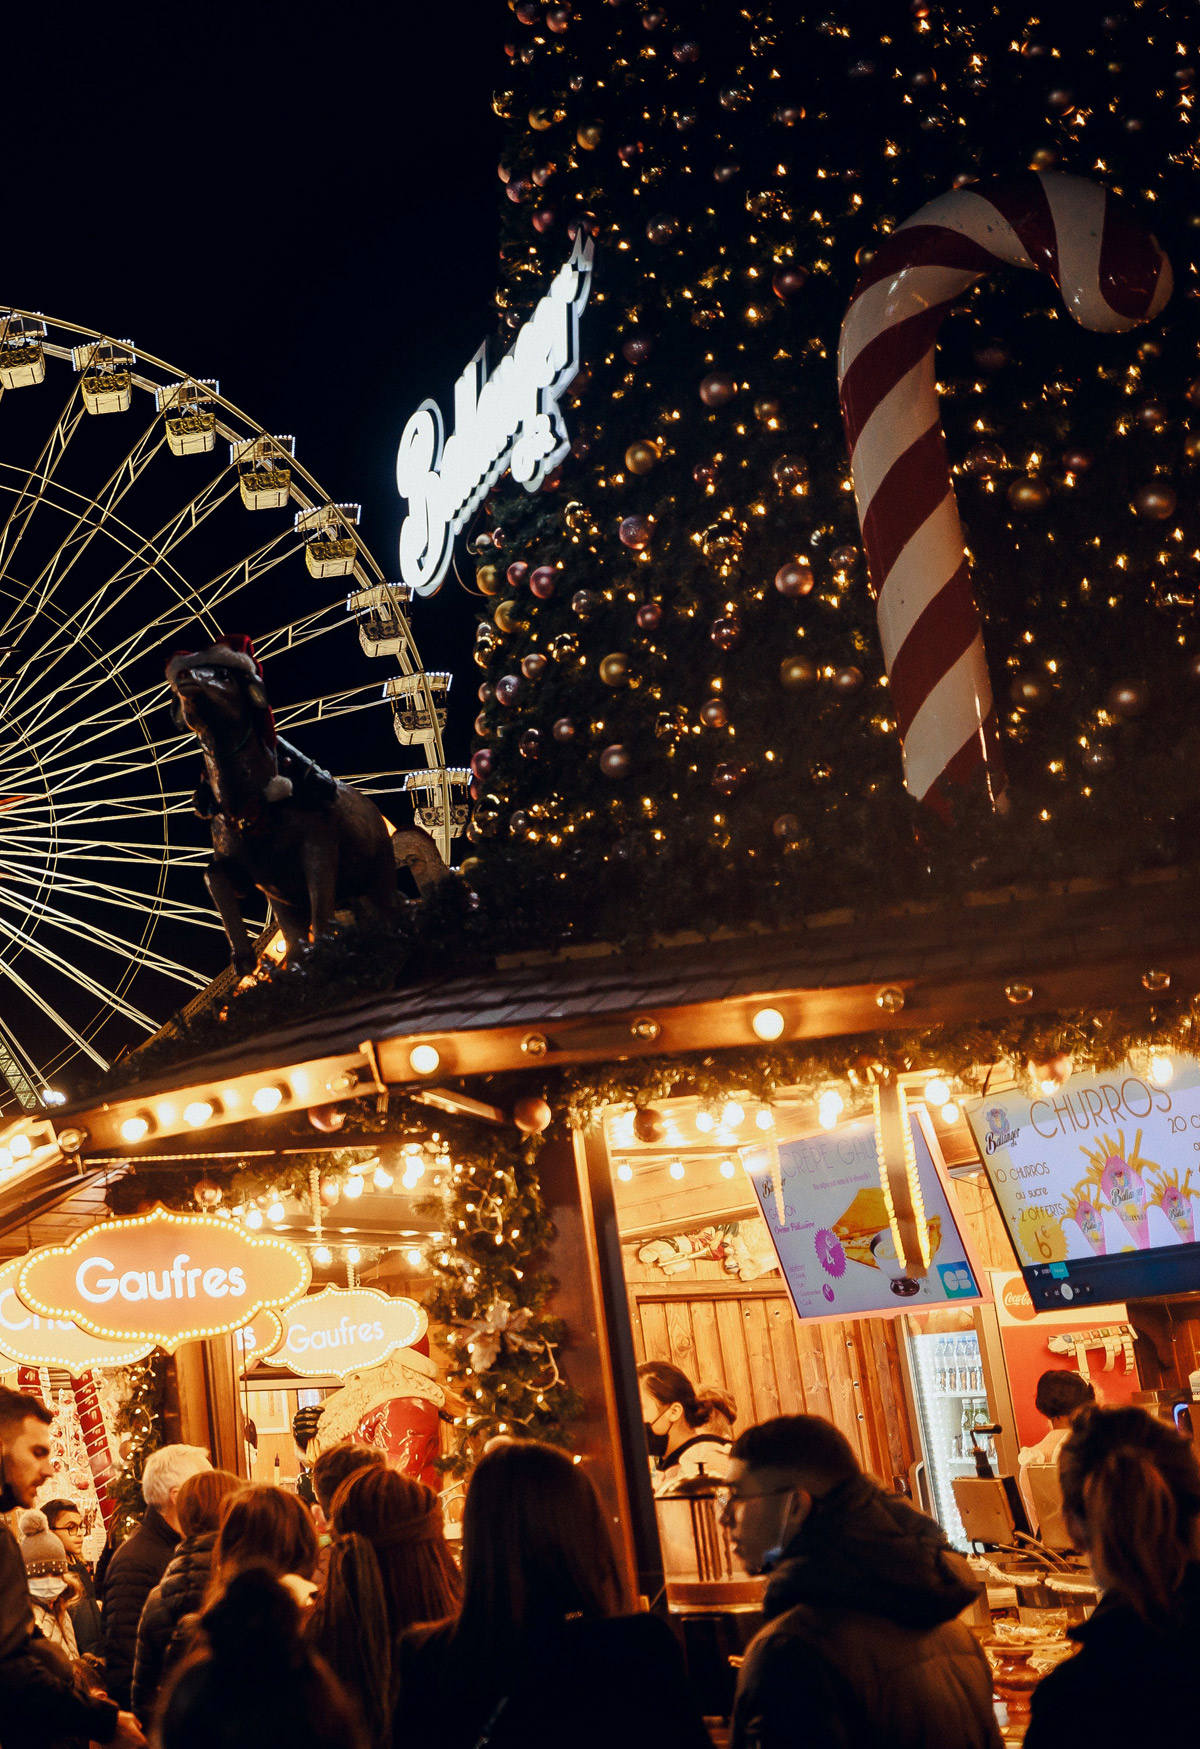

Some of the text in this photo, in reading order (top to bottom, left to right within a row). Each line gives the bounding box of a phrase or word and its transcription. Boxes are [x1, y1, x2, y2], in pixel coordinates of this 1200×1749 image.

[1030, 1077, 1172, 1139] CHURROS
[1009, 1162, 1051, 1181] CHURROS
[1028, 1187, 1049, 1198] sucre
[1027, 1203, 1066, 1220] OFFERTS
[75, 1253, 247, 1304] Gaufres
[286, 1316, 385, 1353] Gaufres
